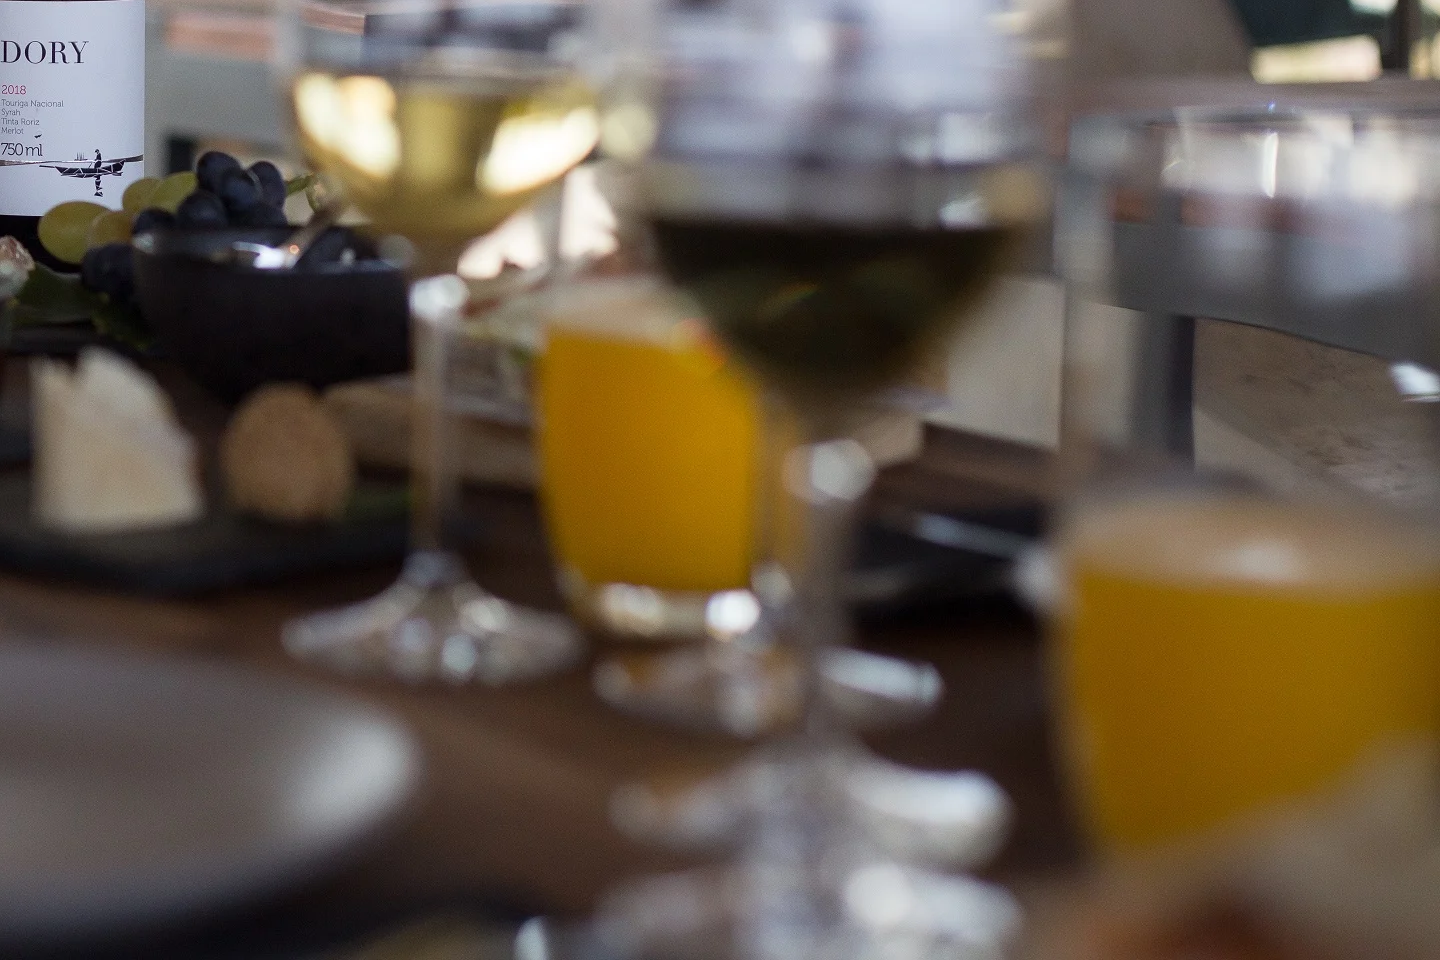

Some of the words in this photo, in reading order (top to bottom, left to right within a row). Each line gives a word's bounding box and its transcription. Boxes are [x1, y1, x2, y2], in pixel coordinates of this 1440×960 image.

[0, 40, 90, 65] DORY
[1, 84, 27, 96] 2018
[1, 99, 29, 109] Touriga
[30, 100, 64, 108] Nacional
[1, 108, 21, 117] Syrah
[1, 117, 19, 126] Tinta
[20, 118, 40, 126] Roriz
[1, 126, 24, 135] Merlot
[1, 142, 24, 157] 750
[25, 143, 43, 157] ml
